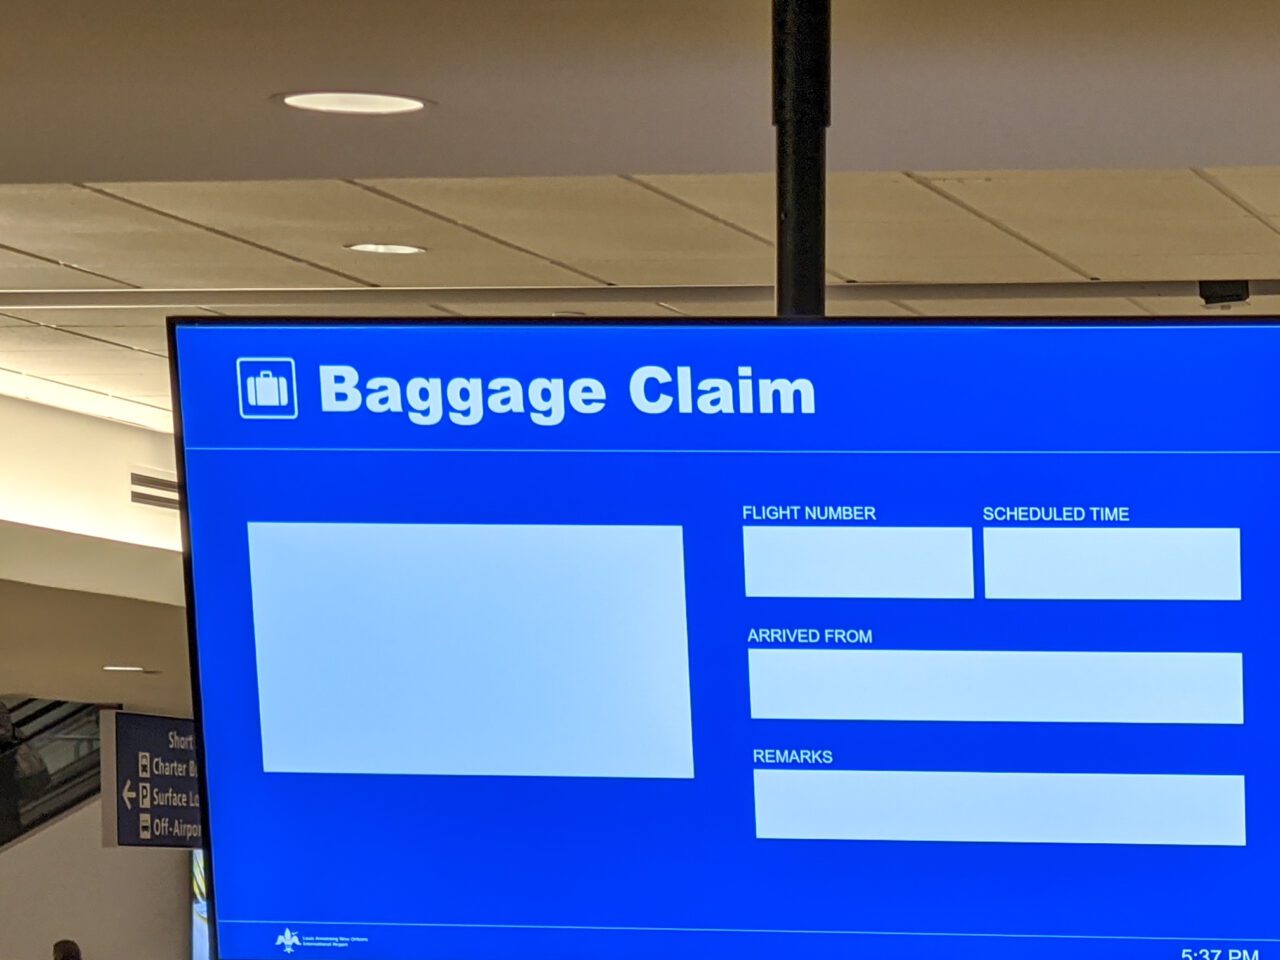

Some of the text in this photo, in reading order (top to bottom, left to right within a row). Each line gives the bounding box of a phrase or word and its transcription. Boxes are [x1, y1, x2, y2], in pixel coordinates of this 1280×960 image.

[319, 365, 816, 426] Baggage Claim
[742, 505, 877, 521] FLIGHT NUMBER
[983, 506, 1130, 522] SCHEDULED TIME
[747, 628, 873, 643] ARRIVED FROM
[168, 731, 194, 749] Short
[753, 749, 834, 764] REMARKS
[152, 757, 187, 777] Charter
[152, 788, 187, 806] Surface
